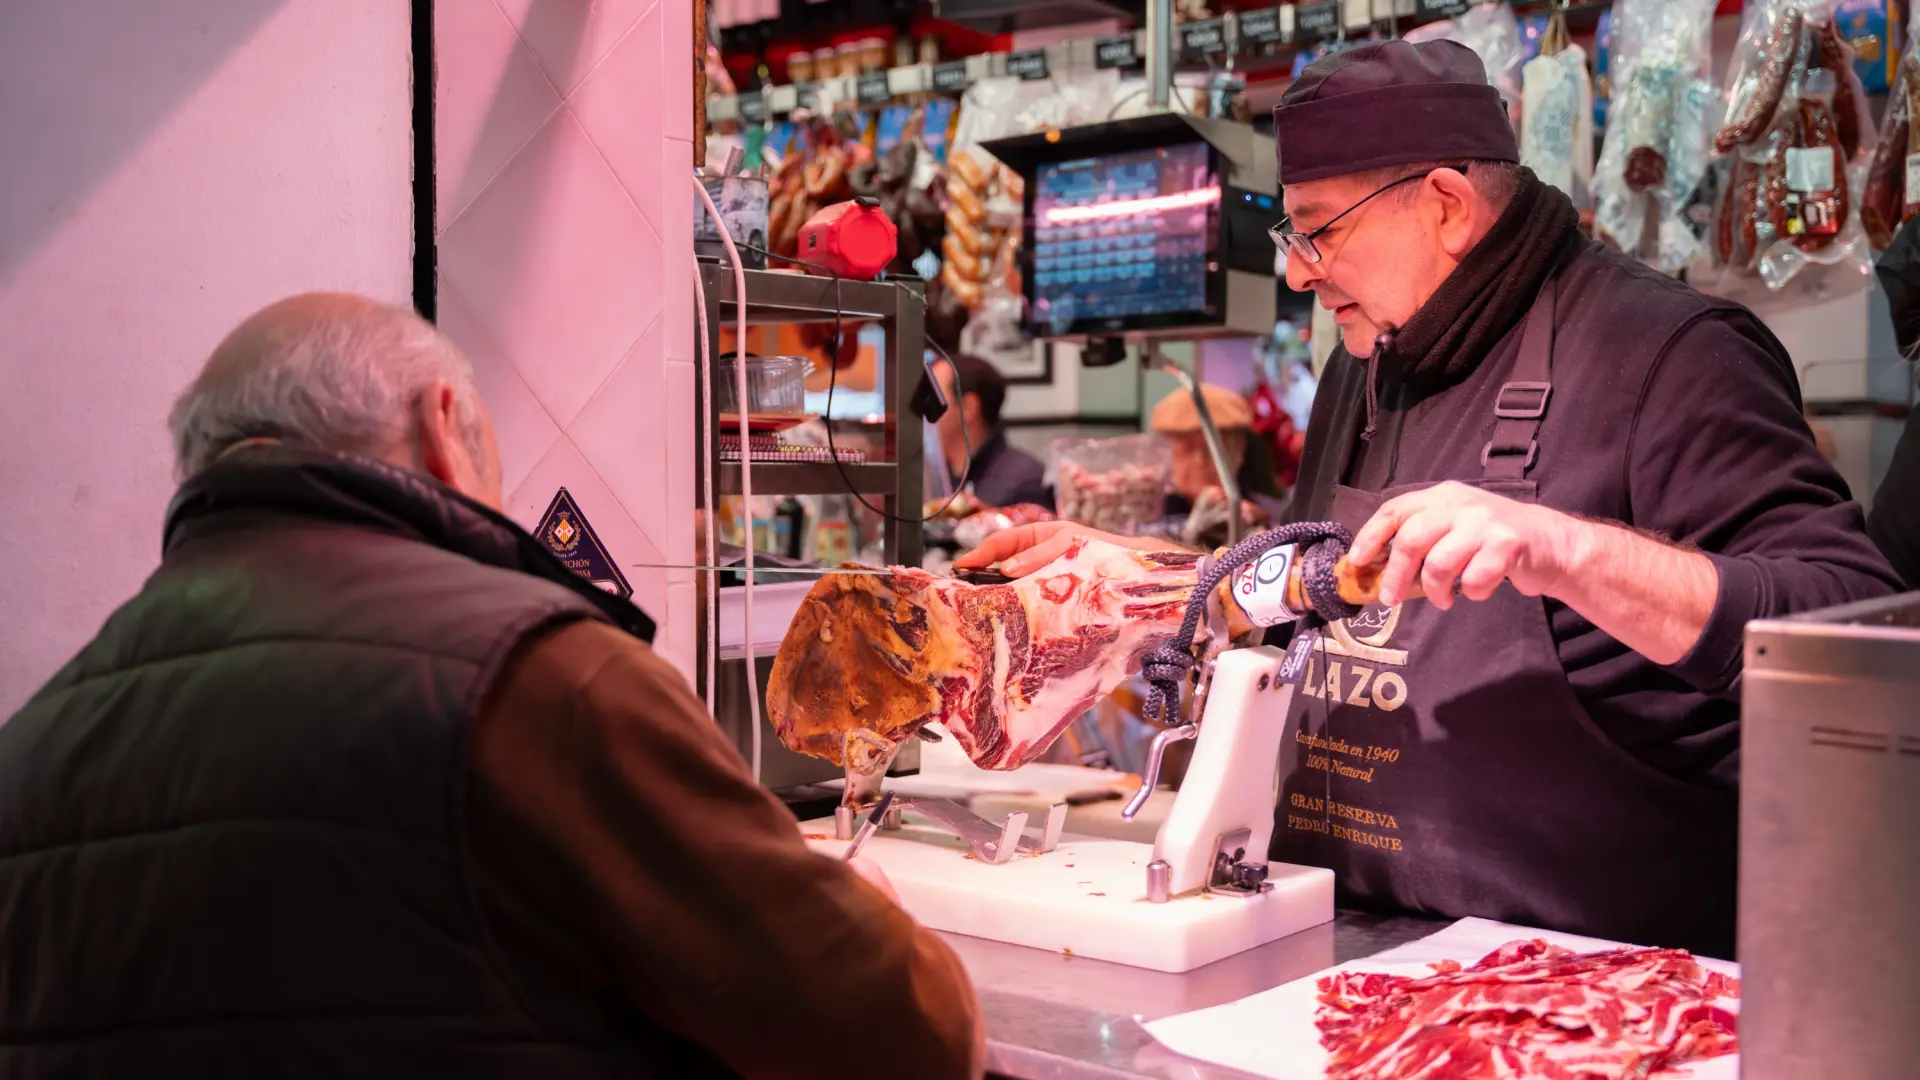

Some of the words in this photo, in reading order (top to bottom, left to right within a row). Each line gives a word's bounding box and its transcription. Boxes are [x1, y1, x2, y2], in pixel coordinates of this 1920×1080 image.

[1302, 657, 1408, 712] LAZO
[1330, 759, 1375, 783] Natural
[1365, 745, 1400, 763] 1940
[1290, 793, 1324, 812] GRAN
[1328, 801, 1398, 829] RESERVA
[1288, 814, 1330, 835] PEDRO
[1332, 824, 1403, 851] ENRIQUE
